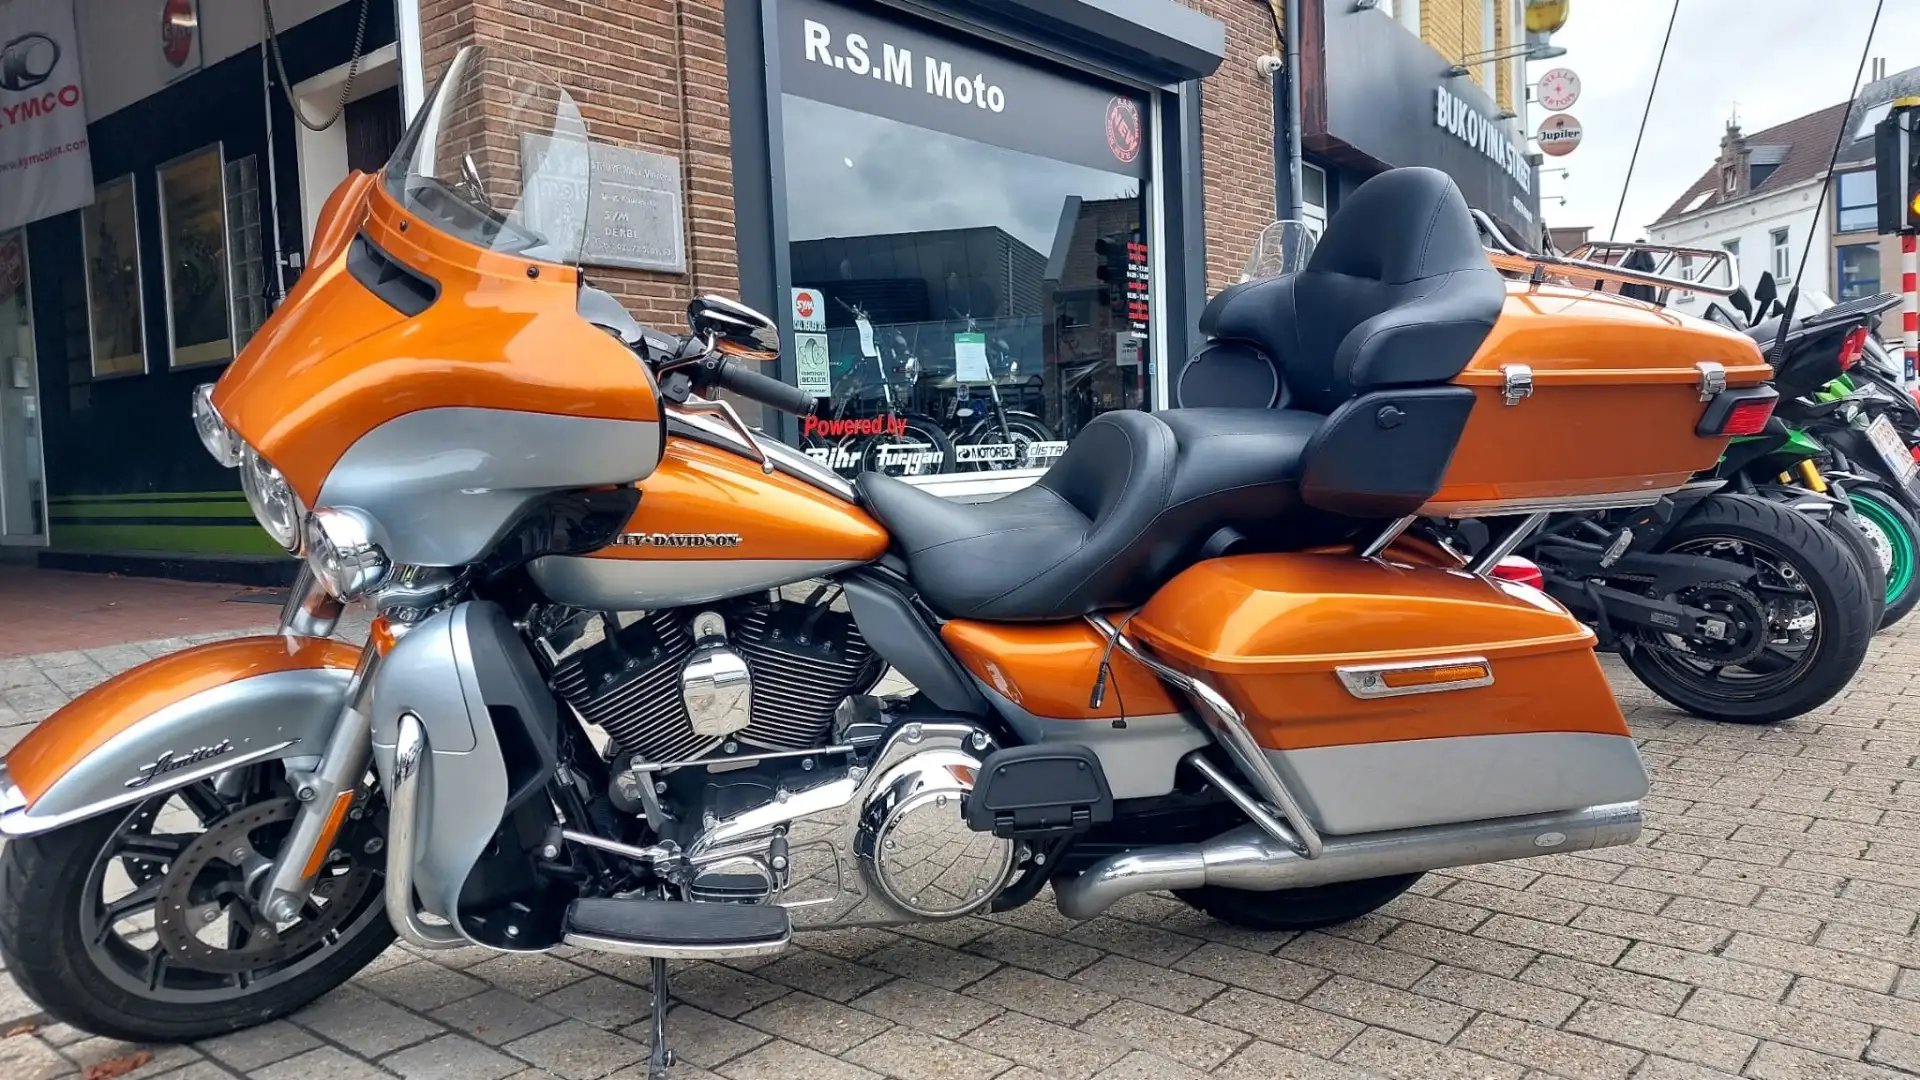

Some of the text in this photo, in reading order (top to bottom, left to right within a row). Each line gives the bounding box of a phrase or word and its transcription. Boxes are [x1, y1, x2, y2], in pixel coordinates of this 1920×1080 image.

[804, 19, 1005, 113] R.S.M Moto
[1542, 71, 1575, 88] STELLA
[0, 84, 80, 129] YMCO
[1540, 129, 1580, 141] Jupiler
[796, 300, 814, 312] SYM
[803, 411, 907, 437] Powered by
[805, 447, 862, 468] Bihr
[972, 446, 1013, 459] MOTOREX
[125, 739, 234, 787] Limited
